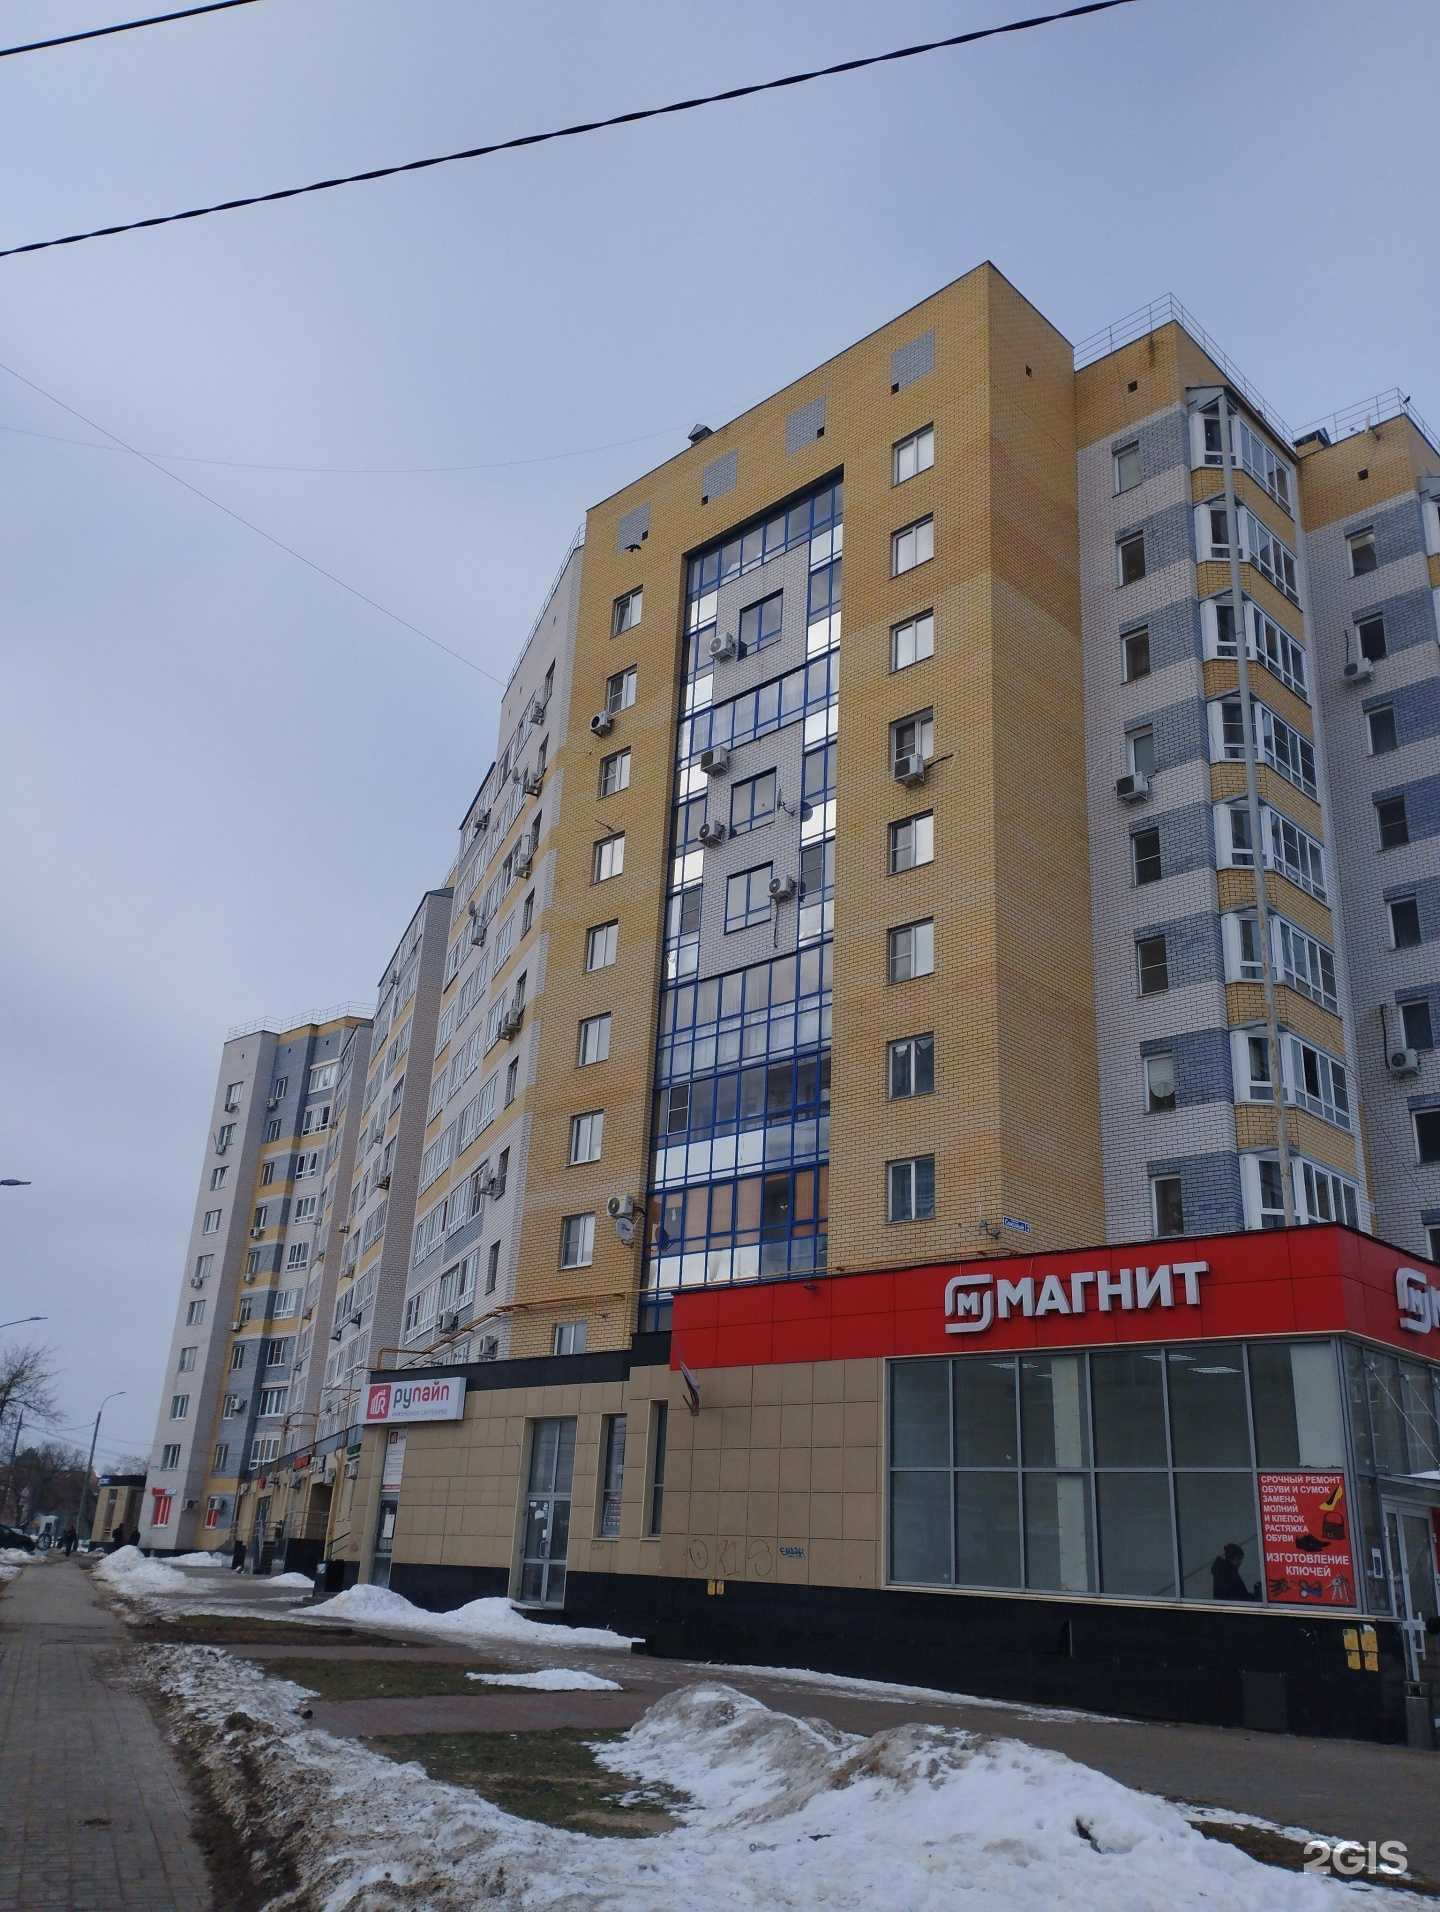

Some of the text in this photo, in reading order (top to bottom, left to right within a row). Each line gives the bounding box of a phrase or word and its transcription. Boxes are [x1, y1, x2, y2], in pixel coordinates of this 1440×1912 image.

[997, 1261, 1209, 1319] МАГНИТ
[393, 1382, 450, 1409] рупайп
[1261, 1475, 1341, 1485] СРОЧНЫЙ РЕМОНТ
[1262, 1485, 1331, 1494] ОБУВИ И СУМОК
[1262, 1495, 1297, 1503] ЗАМЕНА
[1263, 1504, 1299, 1513] МОЛНИЙ
[1264, 1514, 1305, 1523] И КЛЕПОК
[1264, 1524, 1310, 1533] РАСТЯЖКА
[1265, 1534, 1294, 1543] ОБУВИ
[1266, 1552, 1350, 1565] ИЗГОТОВЛЕНИЕ
[1285, 1565, 1331, 1577] КЛЮЧЕЙ
